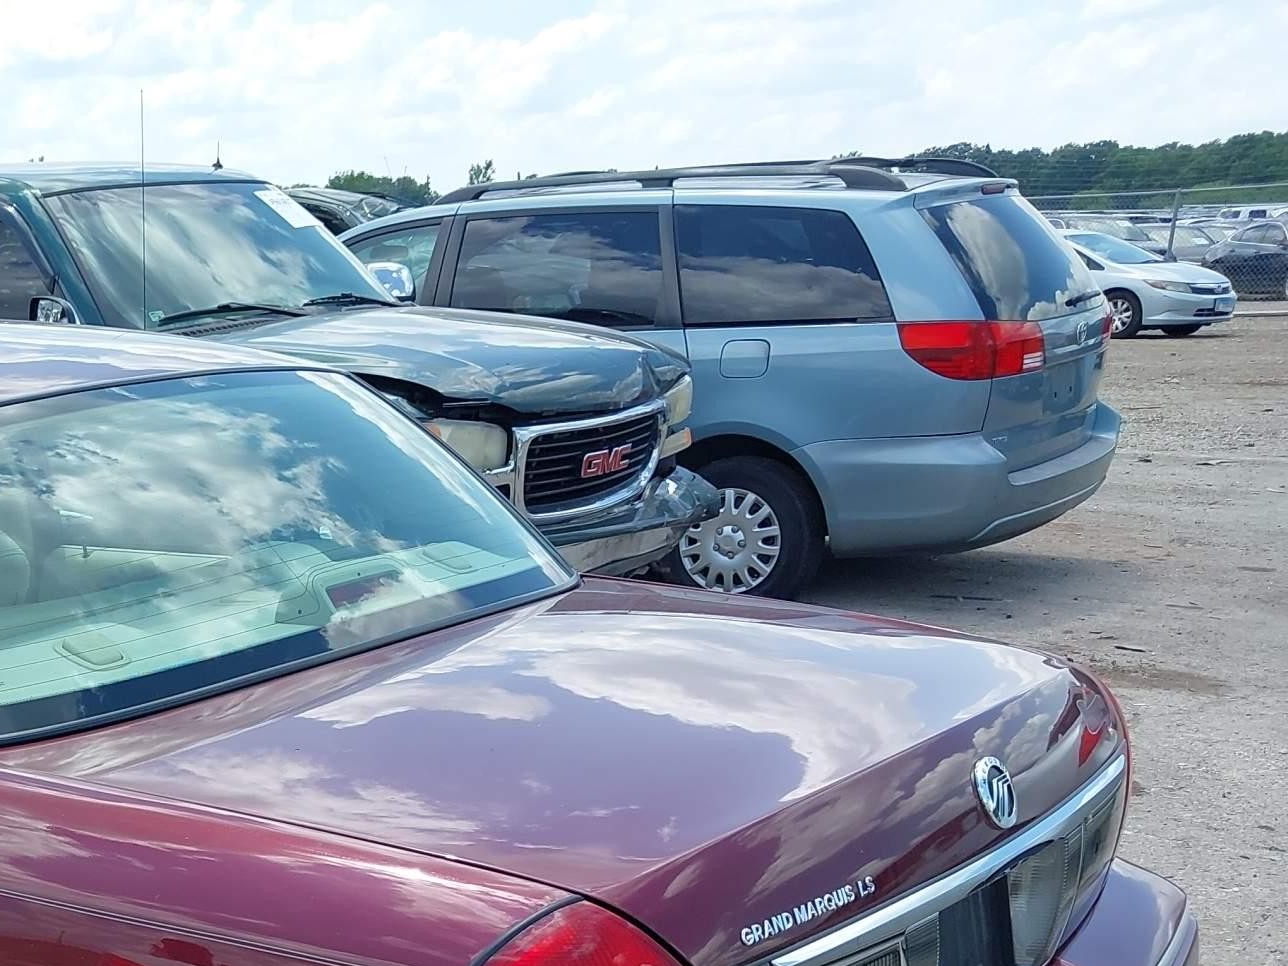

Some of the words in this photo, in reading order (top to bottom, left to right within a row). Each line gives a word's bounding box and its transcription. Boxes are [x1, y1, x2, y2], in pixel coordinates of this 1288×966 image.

[581, 443, 633, 478] GMC
[741, 912, 793, 946] GRAND
[793, 884, 855, 924] MARQUIS
[857, 876, 876, 897] LS
